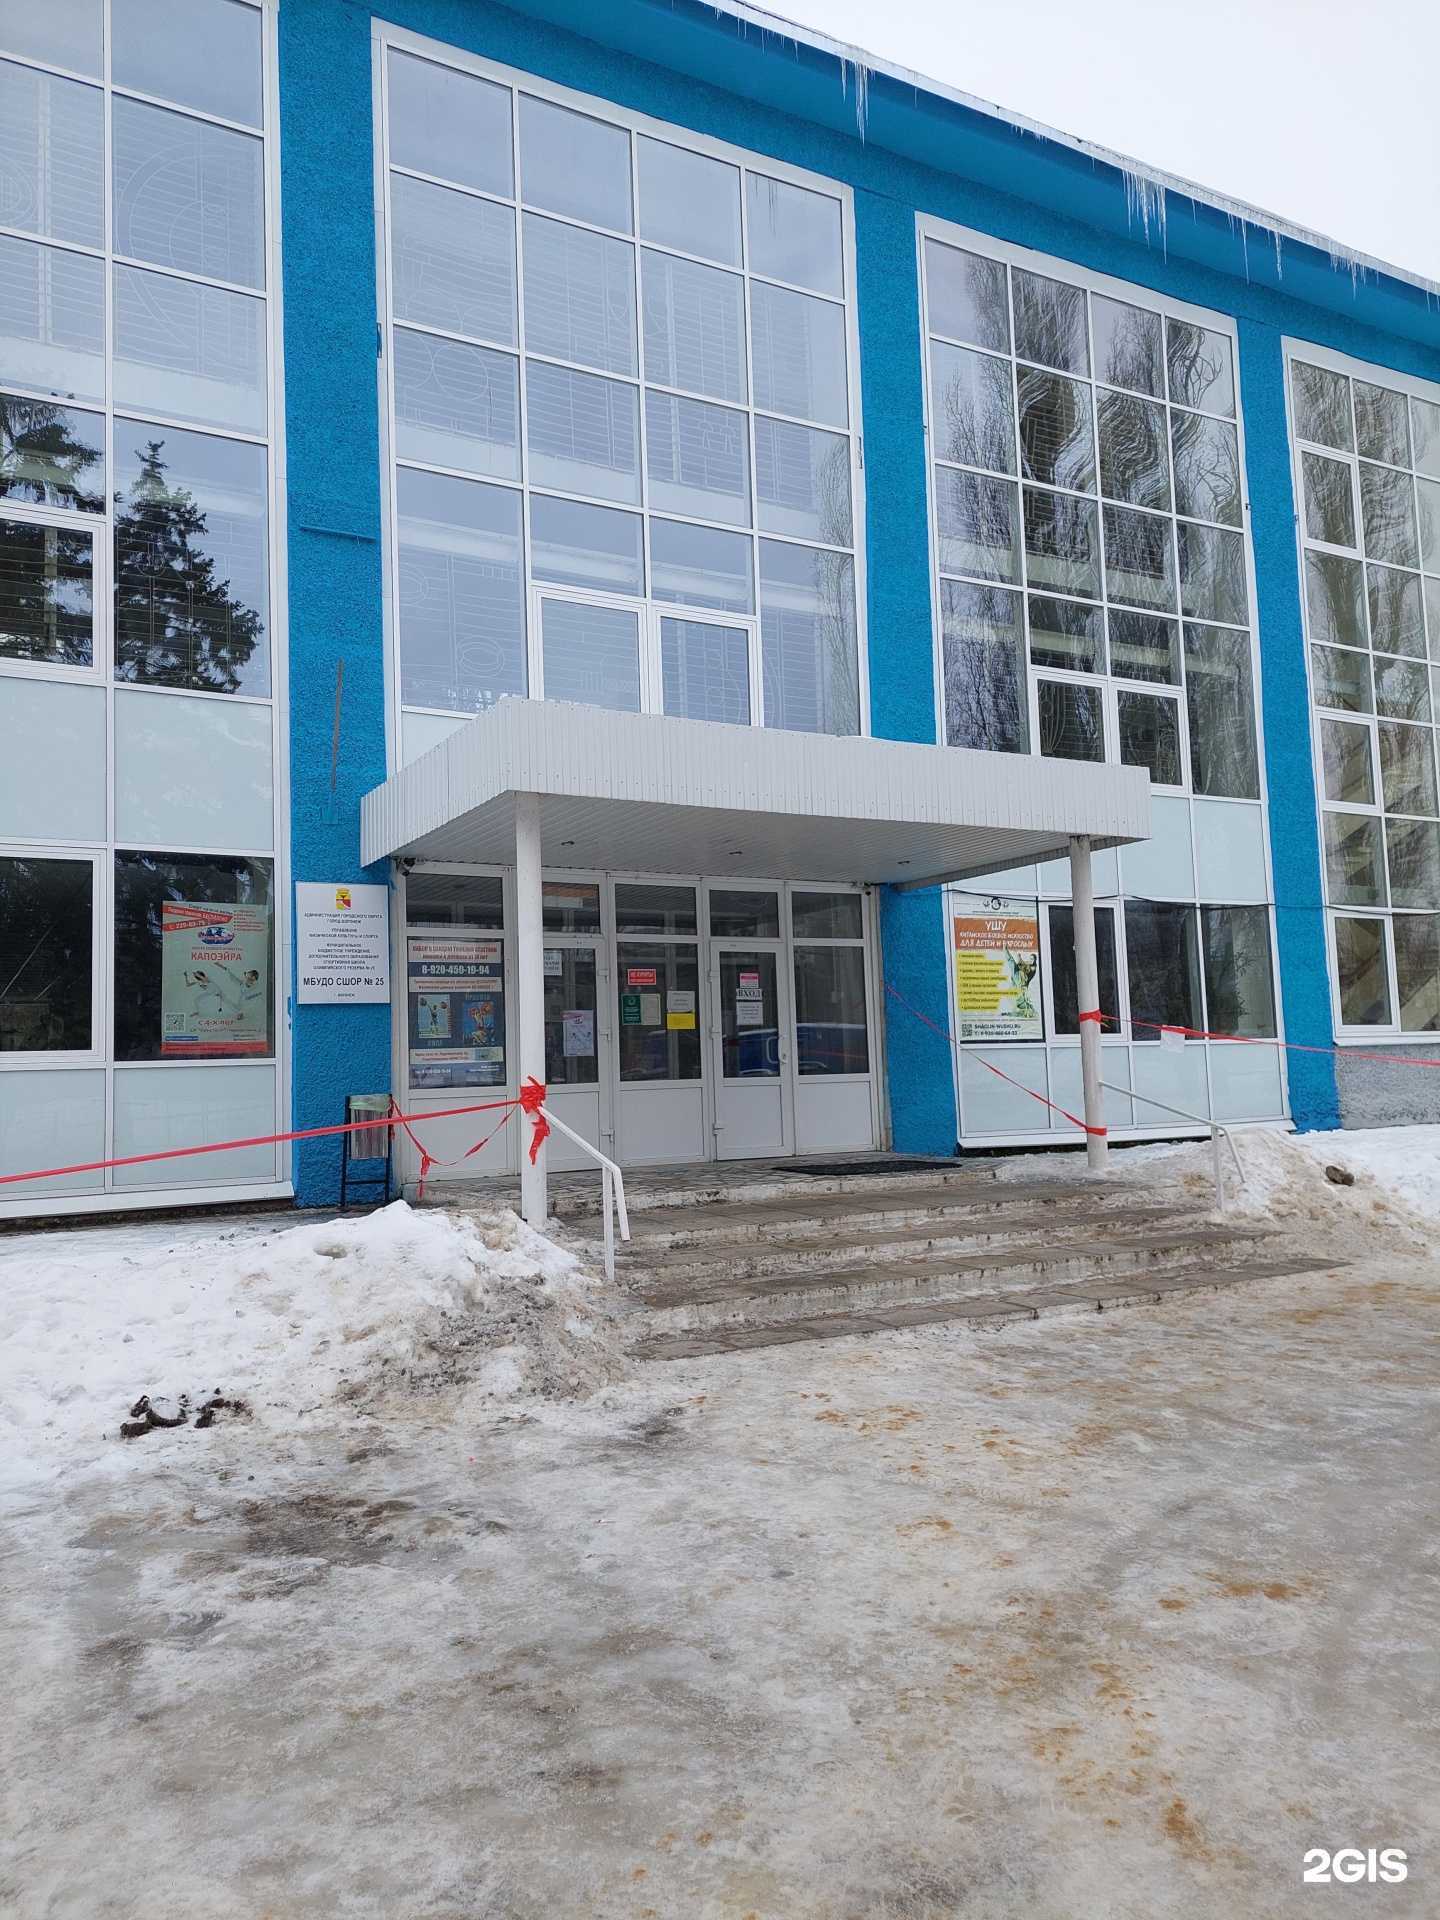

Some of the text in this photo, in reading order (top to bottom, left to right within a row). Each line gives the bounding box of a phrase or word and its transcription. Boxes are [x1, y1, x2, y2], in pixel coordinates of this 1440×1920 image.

[985, 920, 1007, 931] УШУ
[959, 939, 975, 947] ДЛЯ
[975, 939, 995, 947] ДЕТЕЙ
[191, 951, 242, 961] КАПОЭЙРА
[303, 977, 384, 988] МБУДО СШОР № 25
